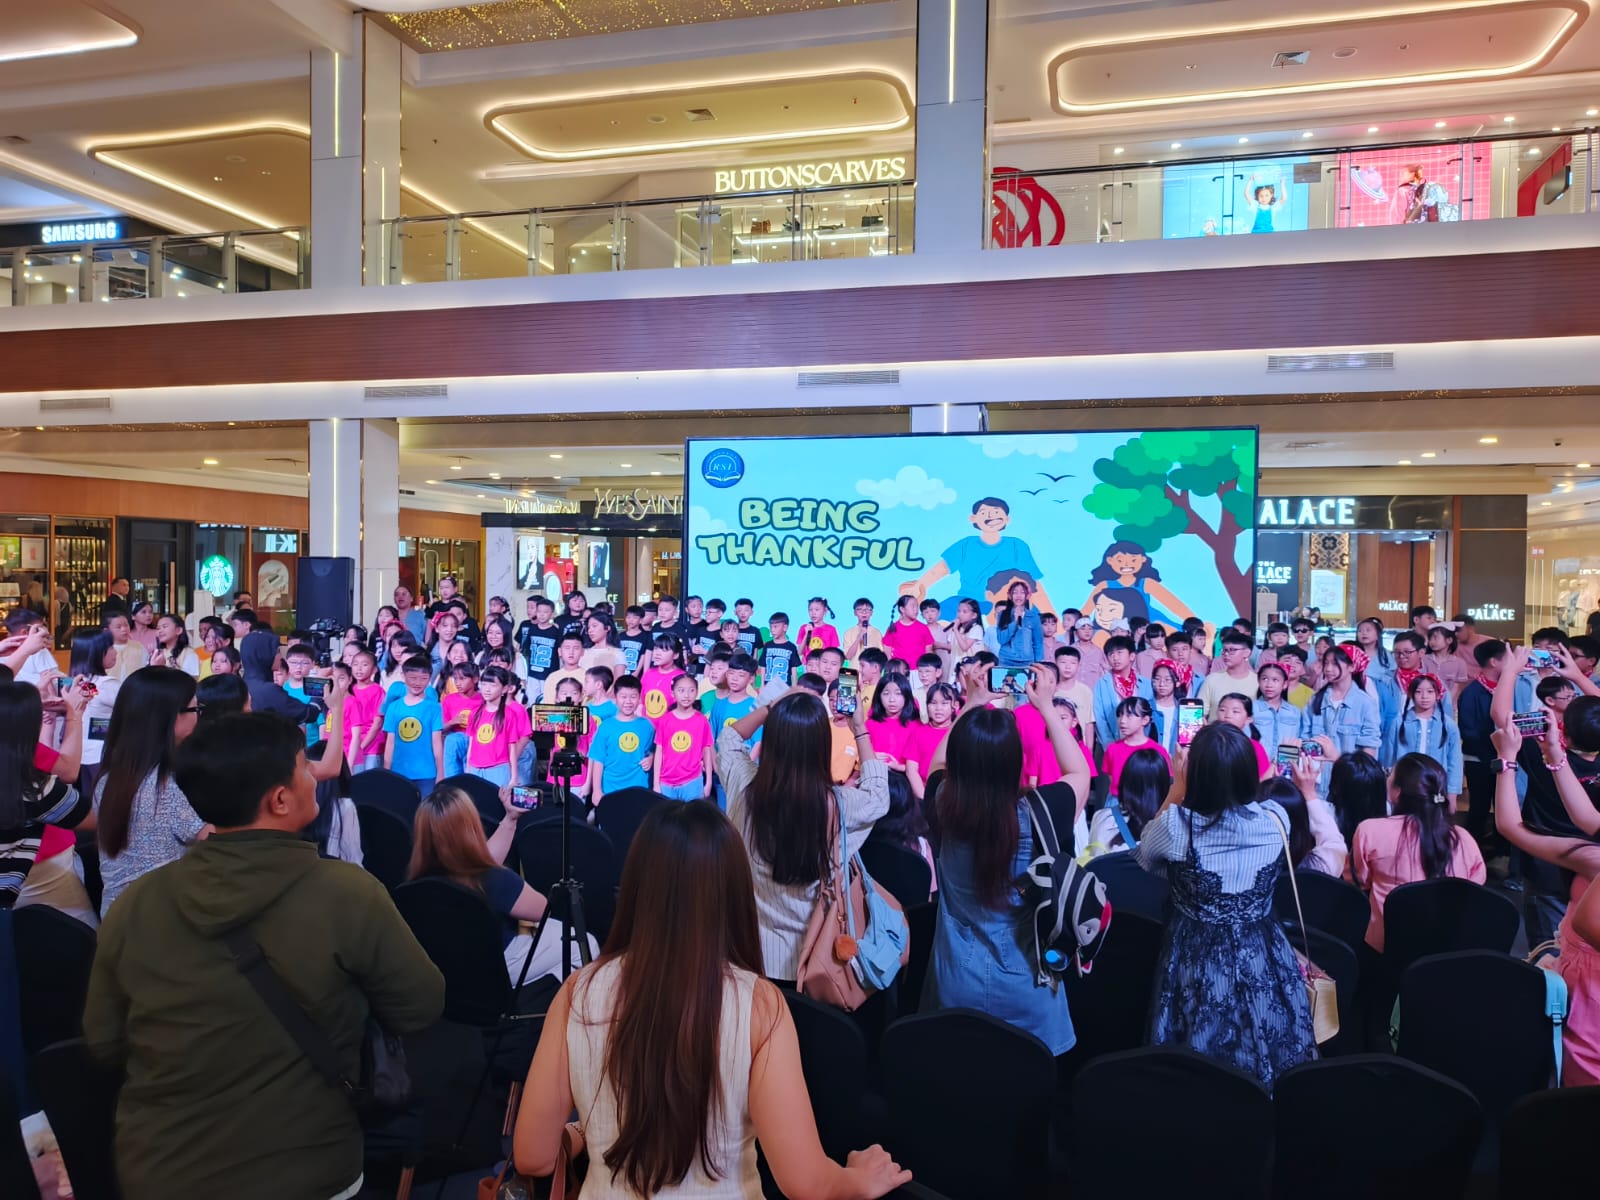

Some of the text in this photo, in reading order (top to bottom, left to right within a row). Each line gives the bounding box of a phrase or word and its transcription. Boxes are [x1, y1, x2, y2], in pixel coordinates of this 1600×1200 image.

[715, 157, 906, 193] BUTTONSCARVES
[41, 221, 117, 243] SAMSUNG
[739, 497, 881, 533] BEING
[695, 532, 925, 571] THANKFUL
[1466, 608, 1516, 621] PALACE
[530, 643, 552, 669] 12
